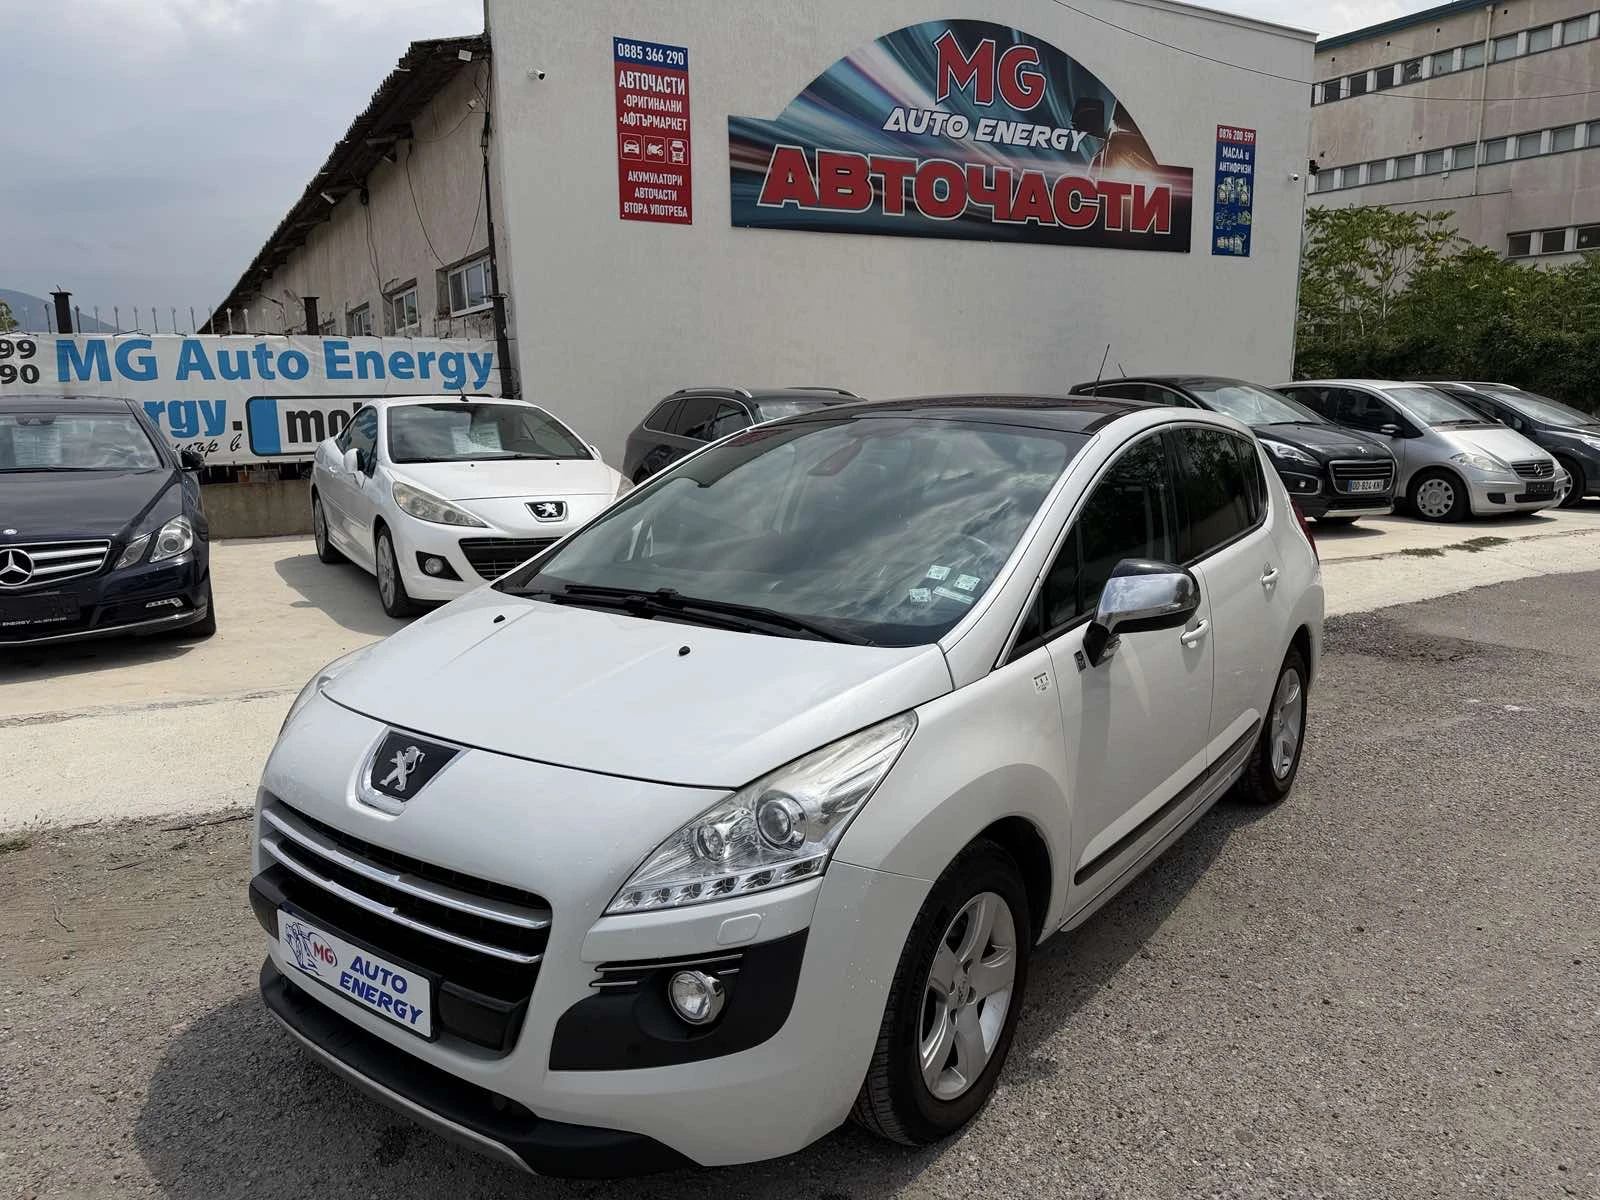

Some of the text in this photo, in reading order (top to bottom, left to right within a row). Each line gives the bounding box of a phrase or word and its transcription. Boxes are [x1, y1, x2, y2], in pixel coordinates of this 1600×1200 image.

[617, 43, 684, 66] 0885 366 290
[932, 29, 1046, 112] MG
[619, 70, 686, 96] АВТОЧАСТИ
[883, 107, 1088, 153] AUTO ENERGY
[1222, 146, 1243, 160] МАСЛА
[627, 170, 683, 187] АКУМУЛАТОРИ
[634, 187, 677, 202] АВТОЧАСТИ
[757, 144, 1172, 235] АВТОЧАСТИ
[624, 202, 688, 218] ВТОРА УПОТРЕБА
[56, 339, 494, 391] MG Auto Energy
[286, 402, 363, 443] mo
[313, 942, 335, 965] MG
[349, 955, 408, 995] AUTO
[339, 971, 424, 1026] ENERGY
